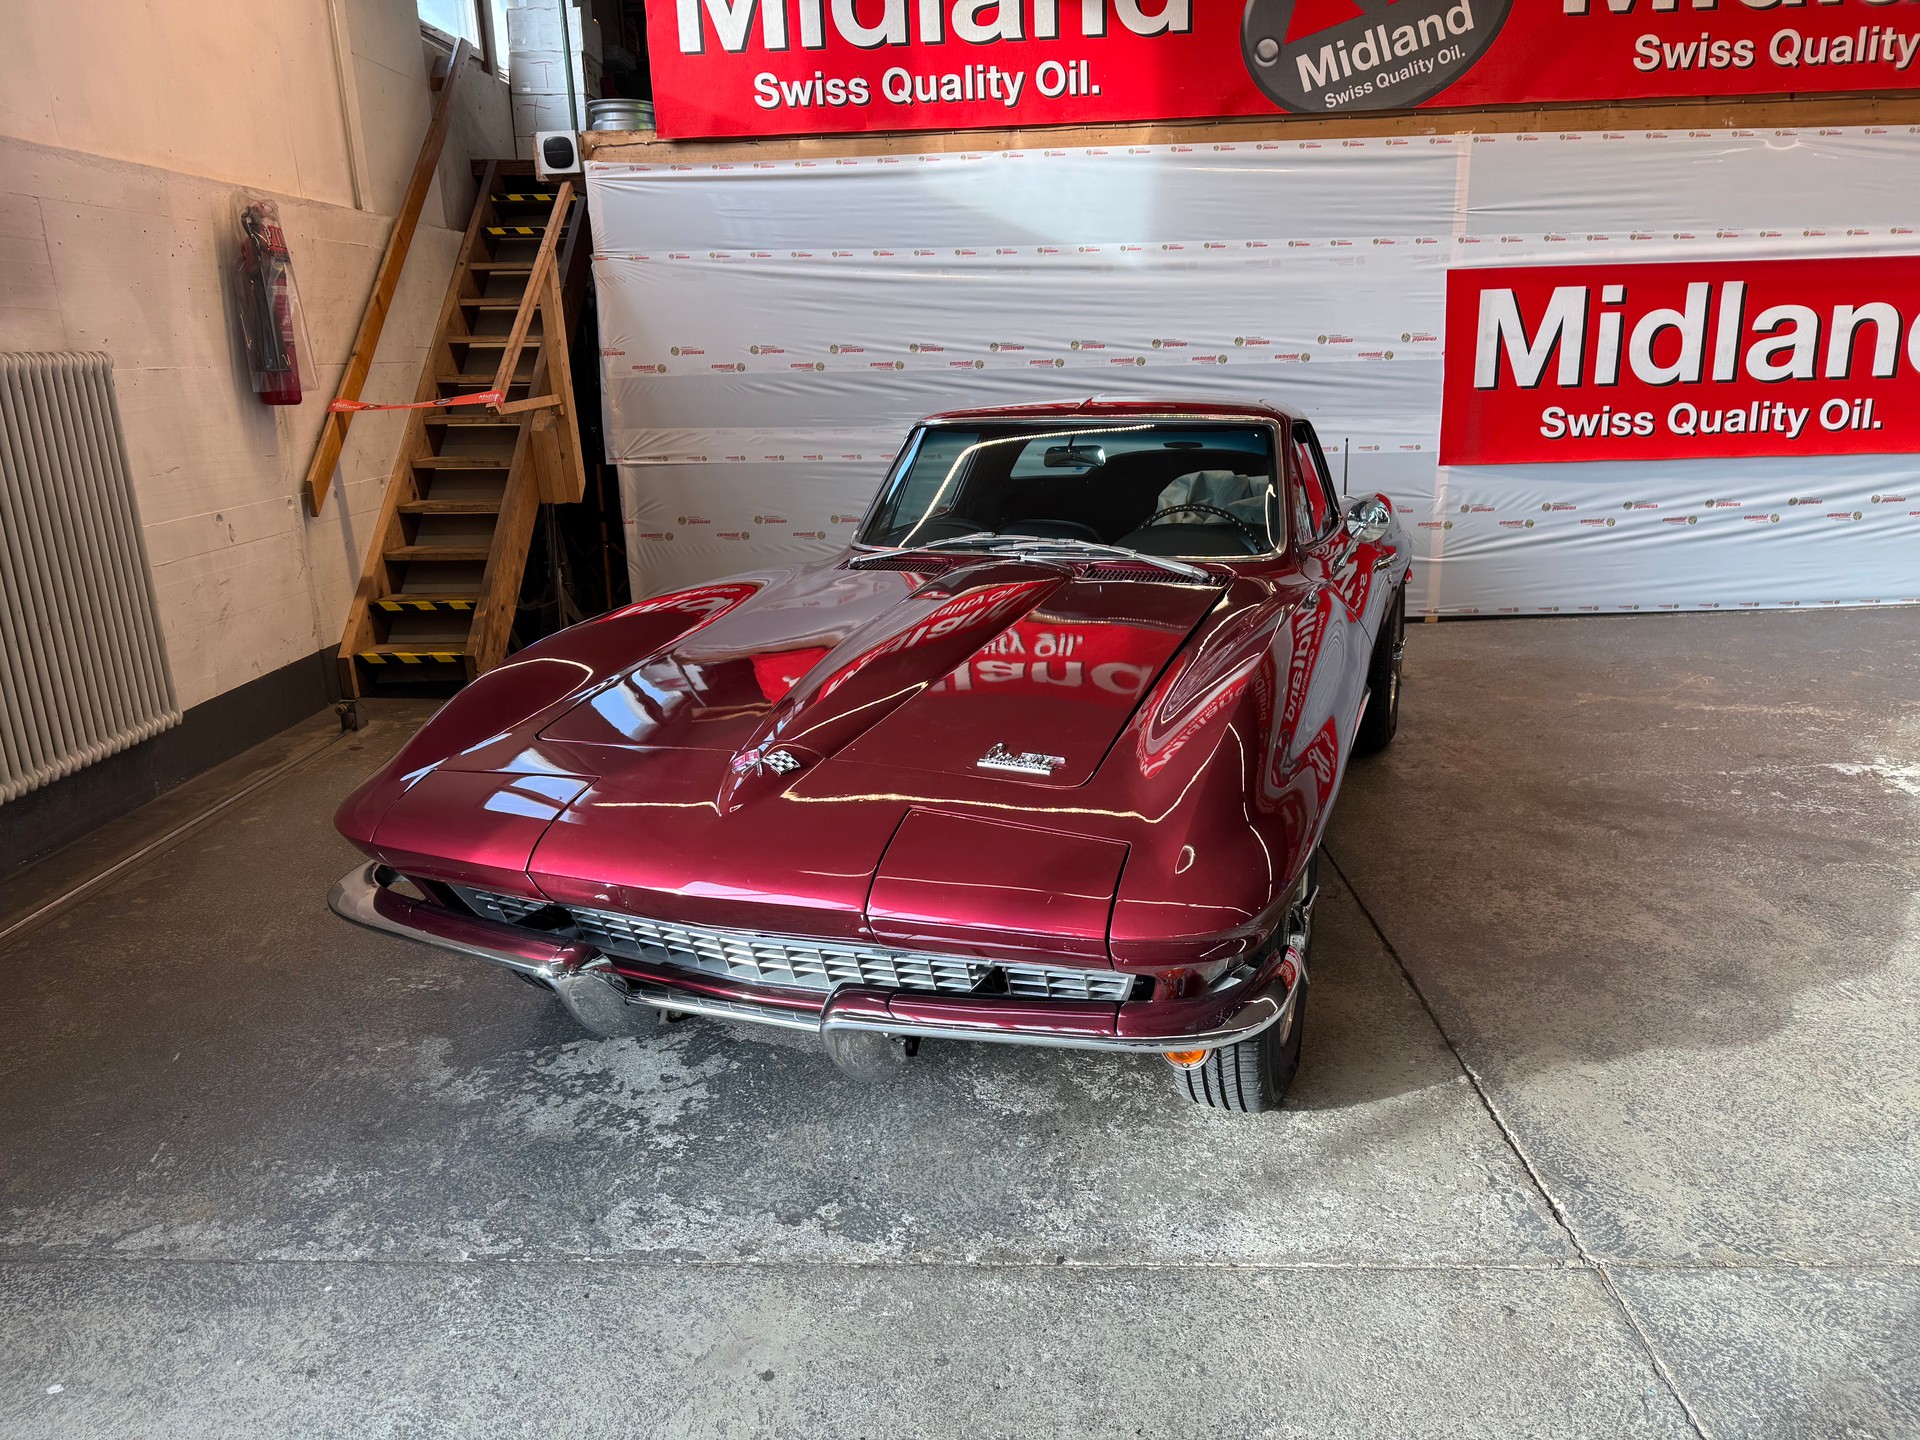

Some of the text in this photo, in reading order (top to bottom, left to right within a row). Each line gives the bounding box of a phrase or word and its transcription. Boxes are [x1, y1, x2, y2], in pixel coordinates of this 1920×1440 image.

[1296, 0, 1475, 93] Midland
[1633, 25, 1920, 71] Swiss Quality
[754, 60, 1101, 108] Swiss Quality Oil.
[1325, 44, 1466, 108] Swiss Quality Oil.
[1474, 281, 1920, 390] Midlan
[1540, 398, 1883, 439] Swiss Quality Oil.
